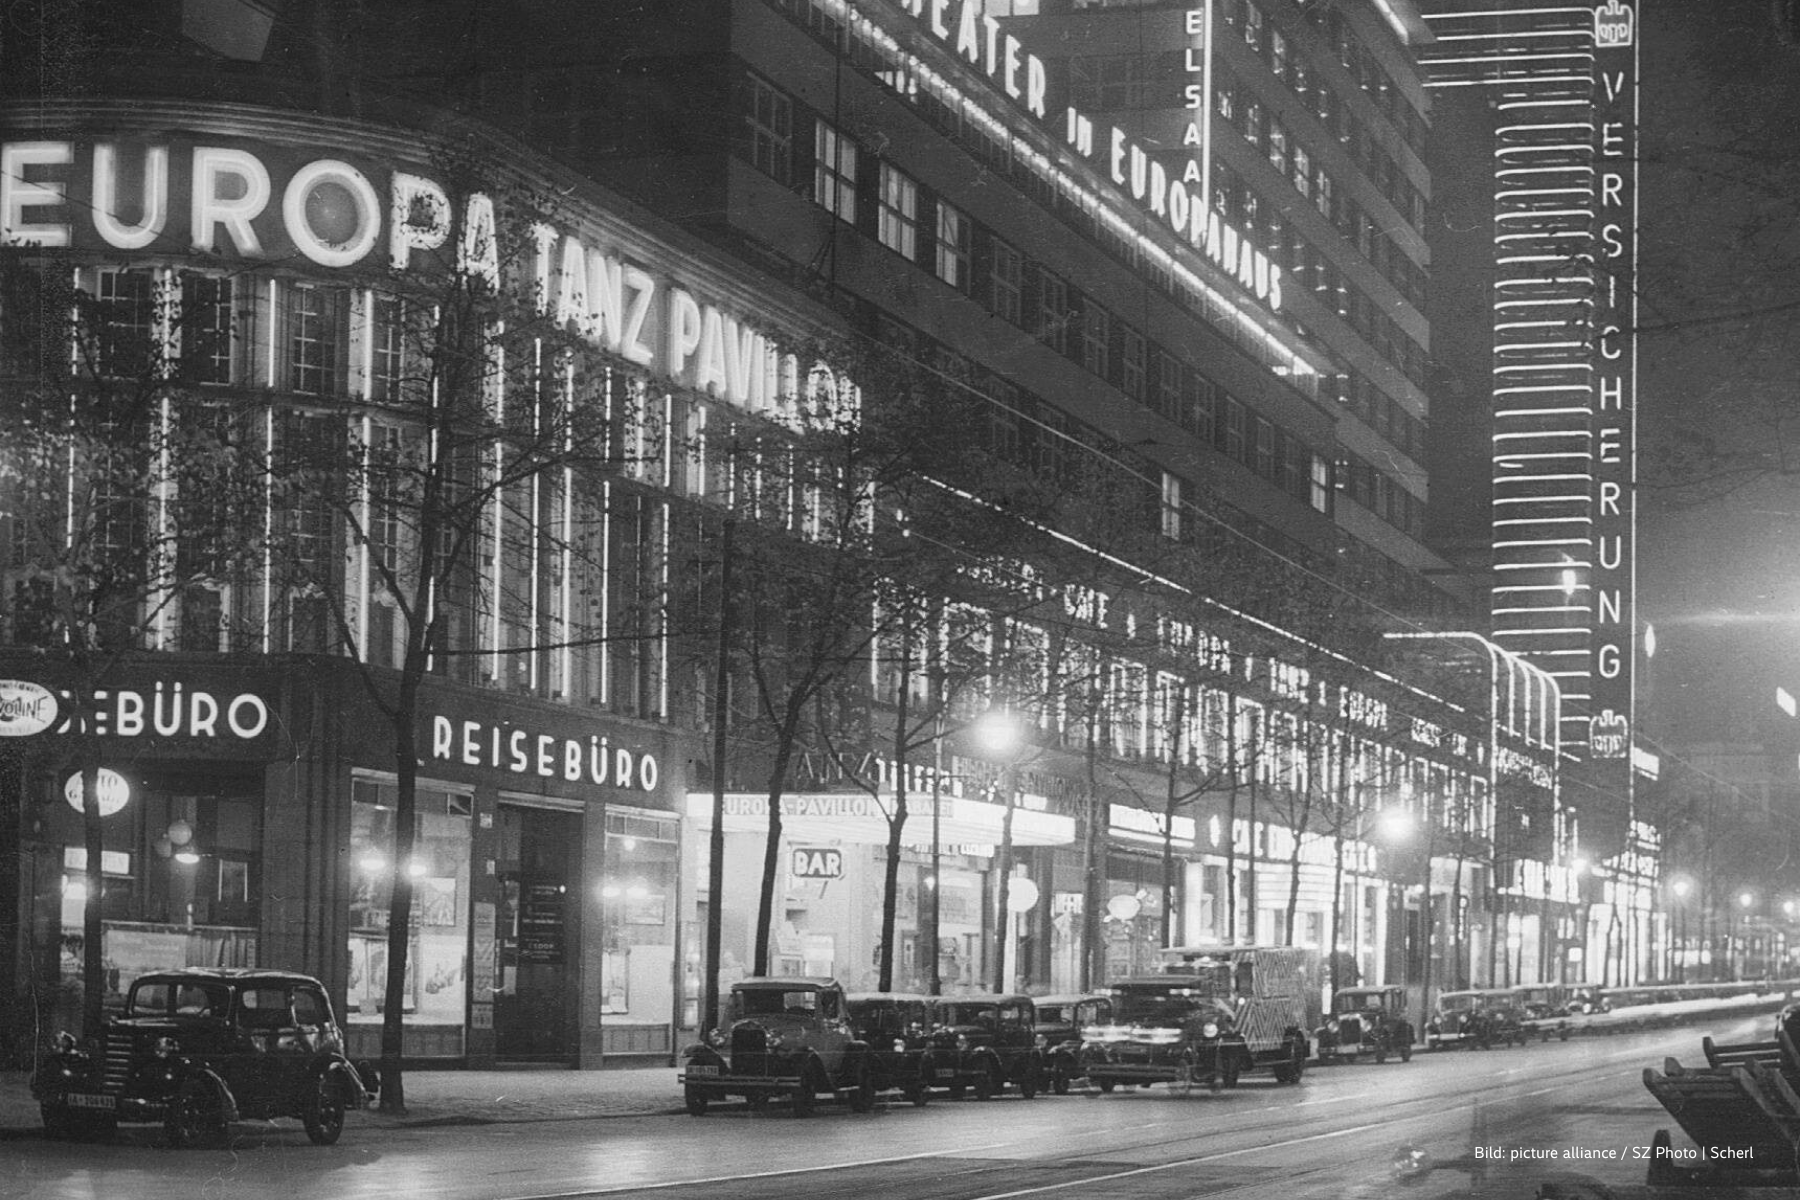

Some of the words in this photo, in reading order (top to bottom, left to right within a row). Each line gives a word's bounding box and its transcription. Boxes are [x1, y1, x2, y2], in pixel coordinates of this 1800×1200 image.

[902, 0, 1046, 118] EATER
[0, 140, 499, 298] EUROPA
[529, 220, 654, 367] TANZ
[1600, 72, 1624, 679] VERSICHERUNG
[433, 715, 658, 791] REISEBÜRO
[794, 851, 840, 876] BAR
